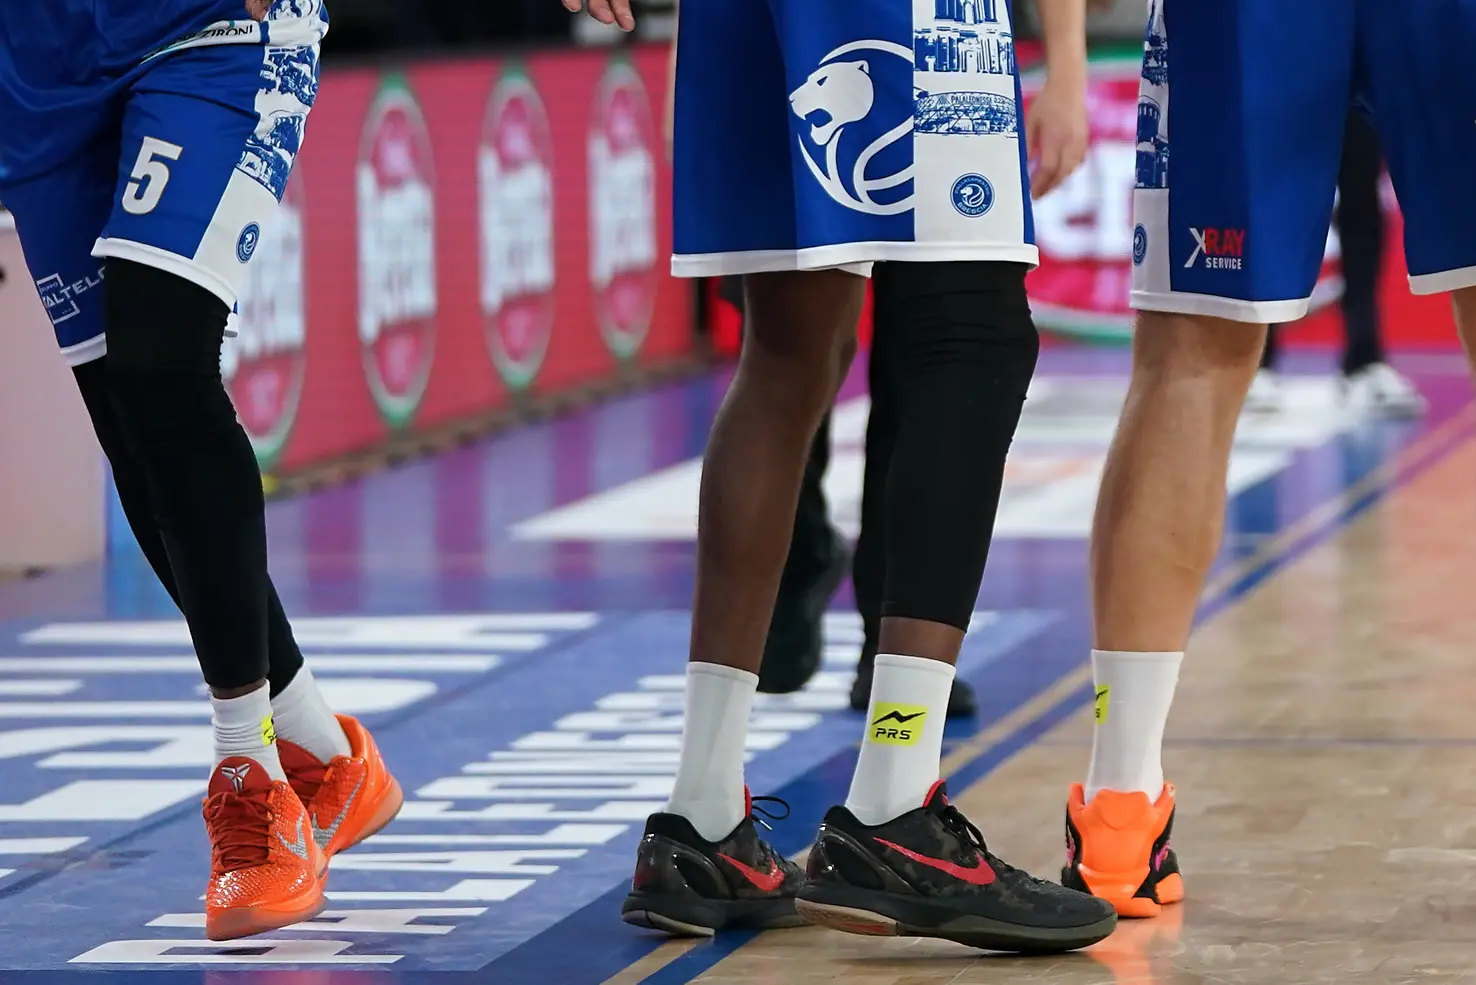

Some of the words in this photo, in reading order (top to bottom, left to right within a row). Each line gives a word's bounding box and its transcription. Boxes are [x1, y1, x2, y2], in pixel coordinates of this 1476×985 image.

[201, 24, 254, 38] ZIRONI
[121, 136, 183, 215] 5
[1205, 257, 1242, 270] SERVICE
[875, 727, 911, 741] PRS
